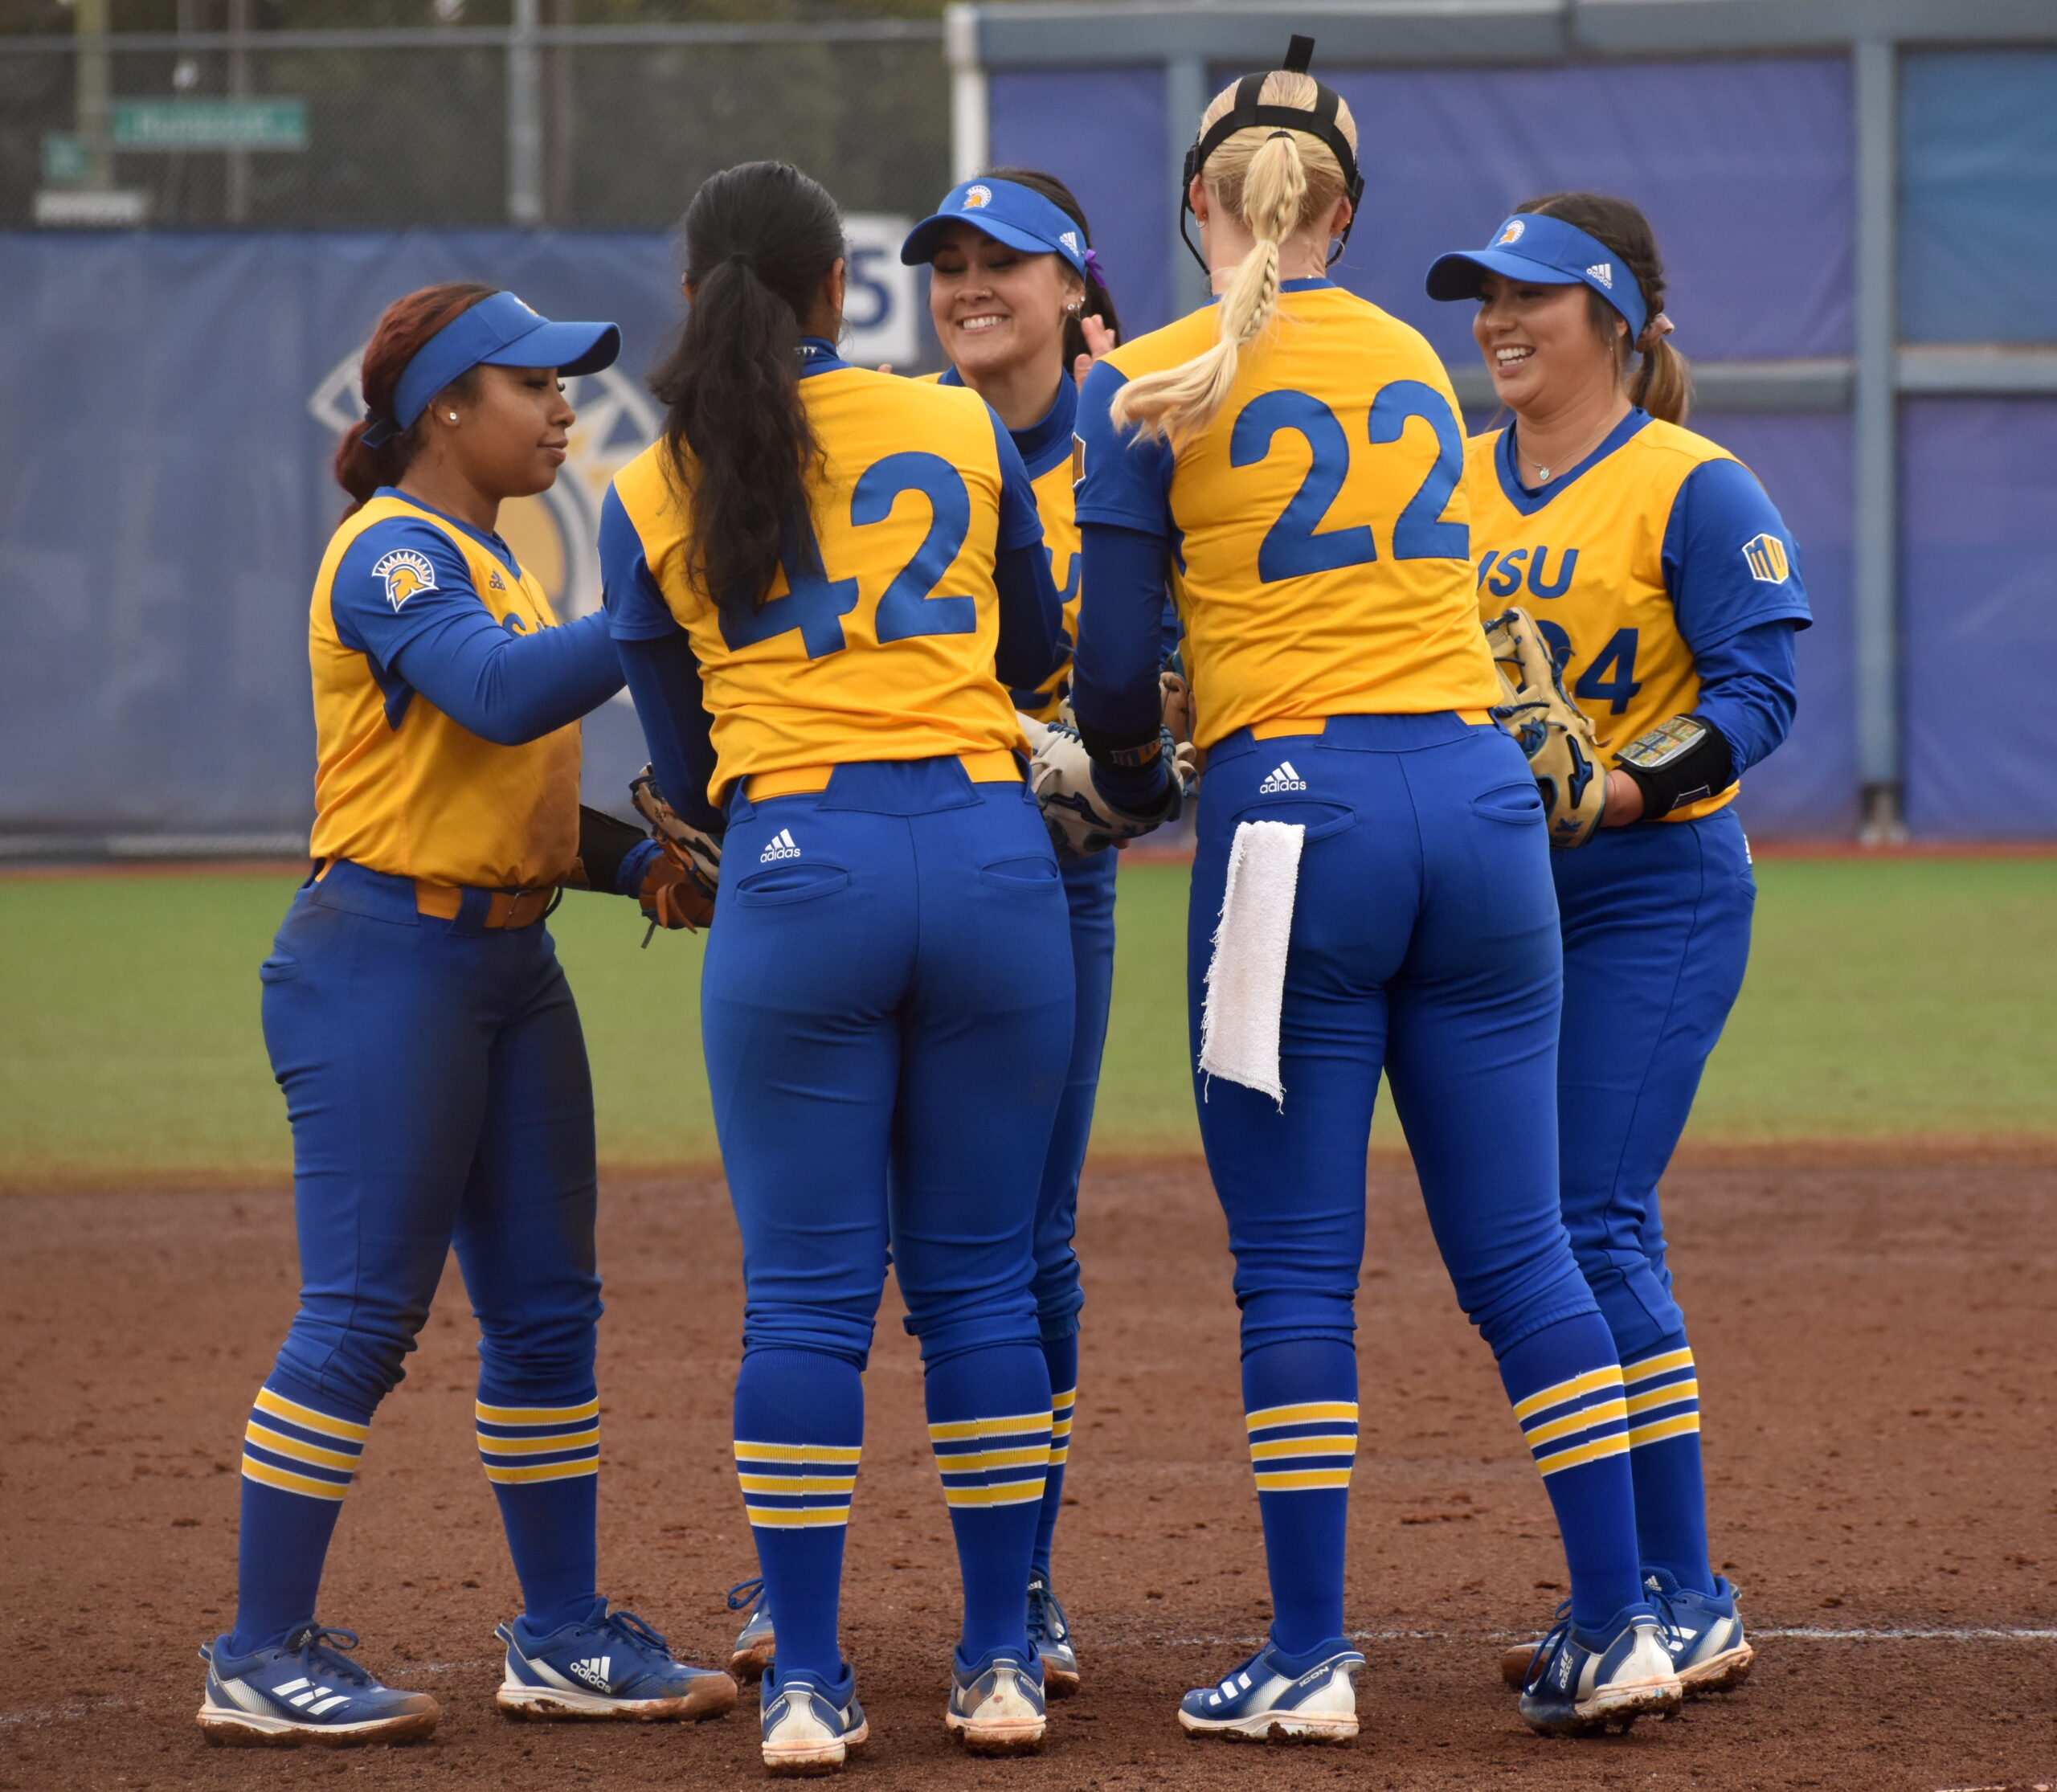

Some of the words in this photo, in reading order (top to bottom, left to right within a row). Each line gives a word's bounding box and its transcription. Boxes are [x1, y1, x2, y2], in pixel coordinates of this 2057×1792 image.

[849, 248, 892, 332] 5
[1586, 268, 1613, 289] adidas
[1230, 379, 1470, 584] 22
[718, 451, 976, 660] 42
[1259, 779, 1307, 794] adidas
[760, 847, 801, 863] adidas
[570, 1662, 611, 1694] adidas
[1298, 1666, 1330, 1688] ICON
